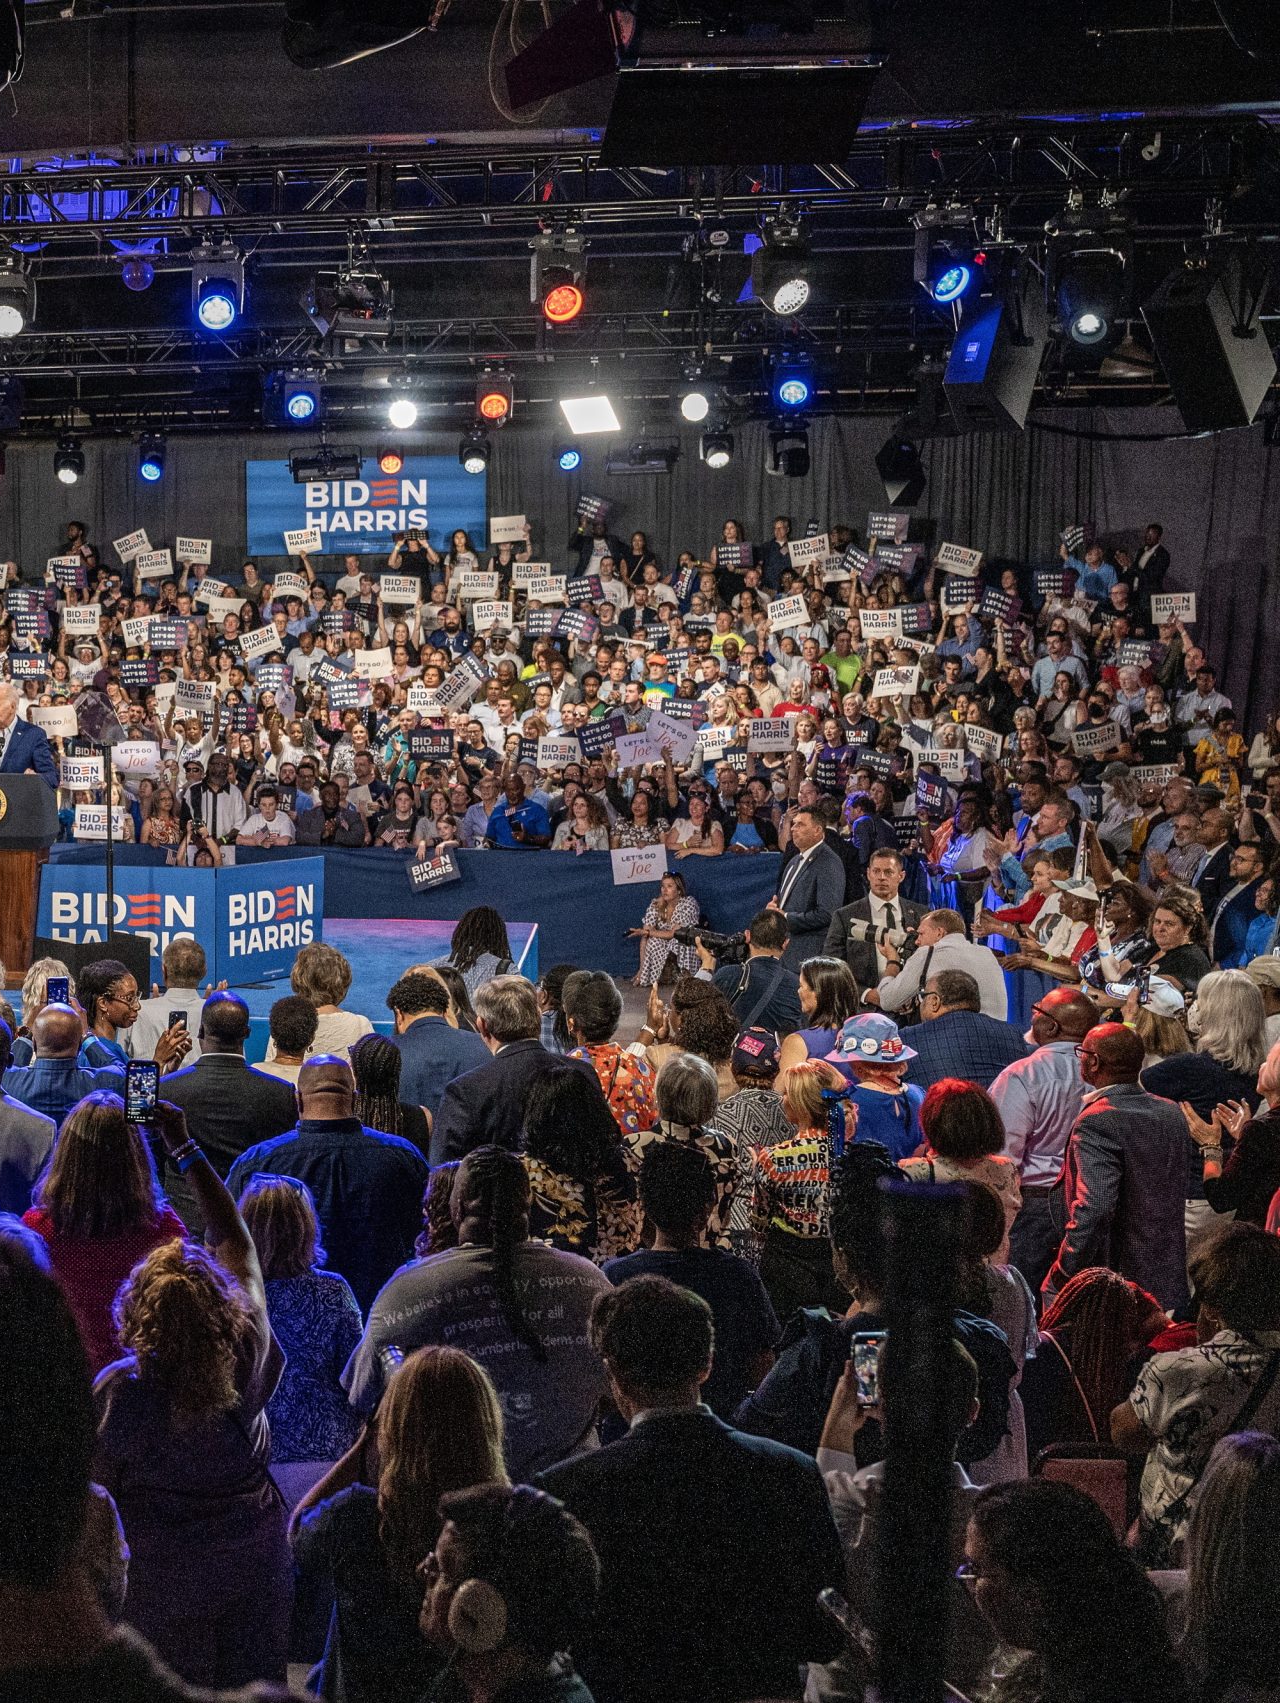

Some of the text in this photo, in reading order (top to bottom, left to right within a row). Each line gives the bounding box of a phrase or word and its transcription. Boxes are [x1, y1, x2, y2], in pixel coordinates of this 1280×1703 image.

[306, 479, 427, 508] BIDEN
[306, 508, 428, 532] HARRIS
[116, 533, 143, 549] BIDEN
[288, 531, 316, 540] BIDEN
[120, 539, 145, 553] HARRIS
[180, 540, 207, 548] BIDEN
[793, 538, 825, 551] BIDEN
[794, 545, 826, 557] HARRIS
[139, 552, 166, 561] BIDEN
[942, 553, 974, 567] HARRIS
[944, 547, 976, 561] BIDEN
[140, 559, 167, 569] HARRIS
[277, 575, 304, 585] BIDEN
[532, 578, 562, 587] BIDEN
[532, 586, 563, 594] HARRIS
[770, 598, 800, 612] BIDEN
[771, 606, 802, 620] HARRIS
[242, 628, 273, 644] BIDEN
[245, 636, 275, 652] HARRIS
[321, 662, 346, 679] BIDEN
[179, 682, 211, 692] BIDEN
[435, 670, 464, 702] BIDEN
[441, 676, 470, 706] HARRIS
[178, 689, 211, 700] HARRIS
[657, 720, 687, 739] LET'S GO
[753, 720, 789, 730] BIDEN
[752, 730, 789, 739] HARRIS
[968, 728, 998, 744] BIDEN
[1076, 724, 1116, 741] BIDEN
[656, 731, 678, 749] Joe
[968, 736, 996, 751] HARRIS
[1077, 733, 1116, 747] HARRIS
[542, 744, 576, 753] BIDEN
[630, 744, 651, 759] Joe
[126, 755, 147, 769] Joe
[542, 753, 576, 761] HARRIS
[918, 753, 958, 761] BIDEN
[63, 766, 98, 774] BIDEN
[1135, 767, 1173, 778] BIDEN
[63, 774, 98, 783] HARRIS
[918, 778, 942, 797] BIDEN
[80, 814, 119, 823] BIDEN
[80, 823, 119, 832] HARRS
[411, 853, 450, 876] BIDEN
[621, 854, 642, 862] LET'S
[414, 864, 453, 884] HARRIS
[628, 861, 651, 878] Joe
[52, 892, 194, 928] BIDEN
[229, 884, 314, 926] BIDEN
[229, 920, 314, 957] HARRIS
[798, 1153, 825, 1163] OUR
